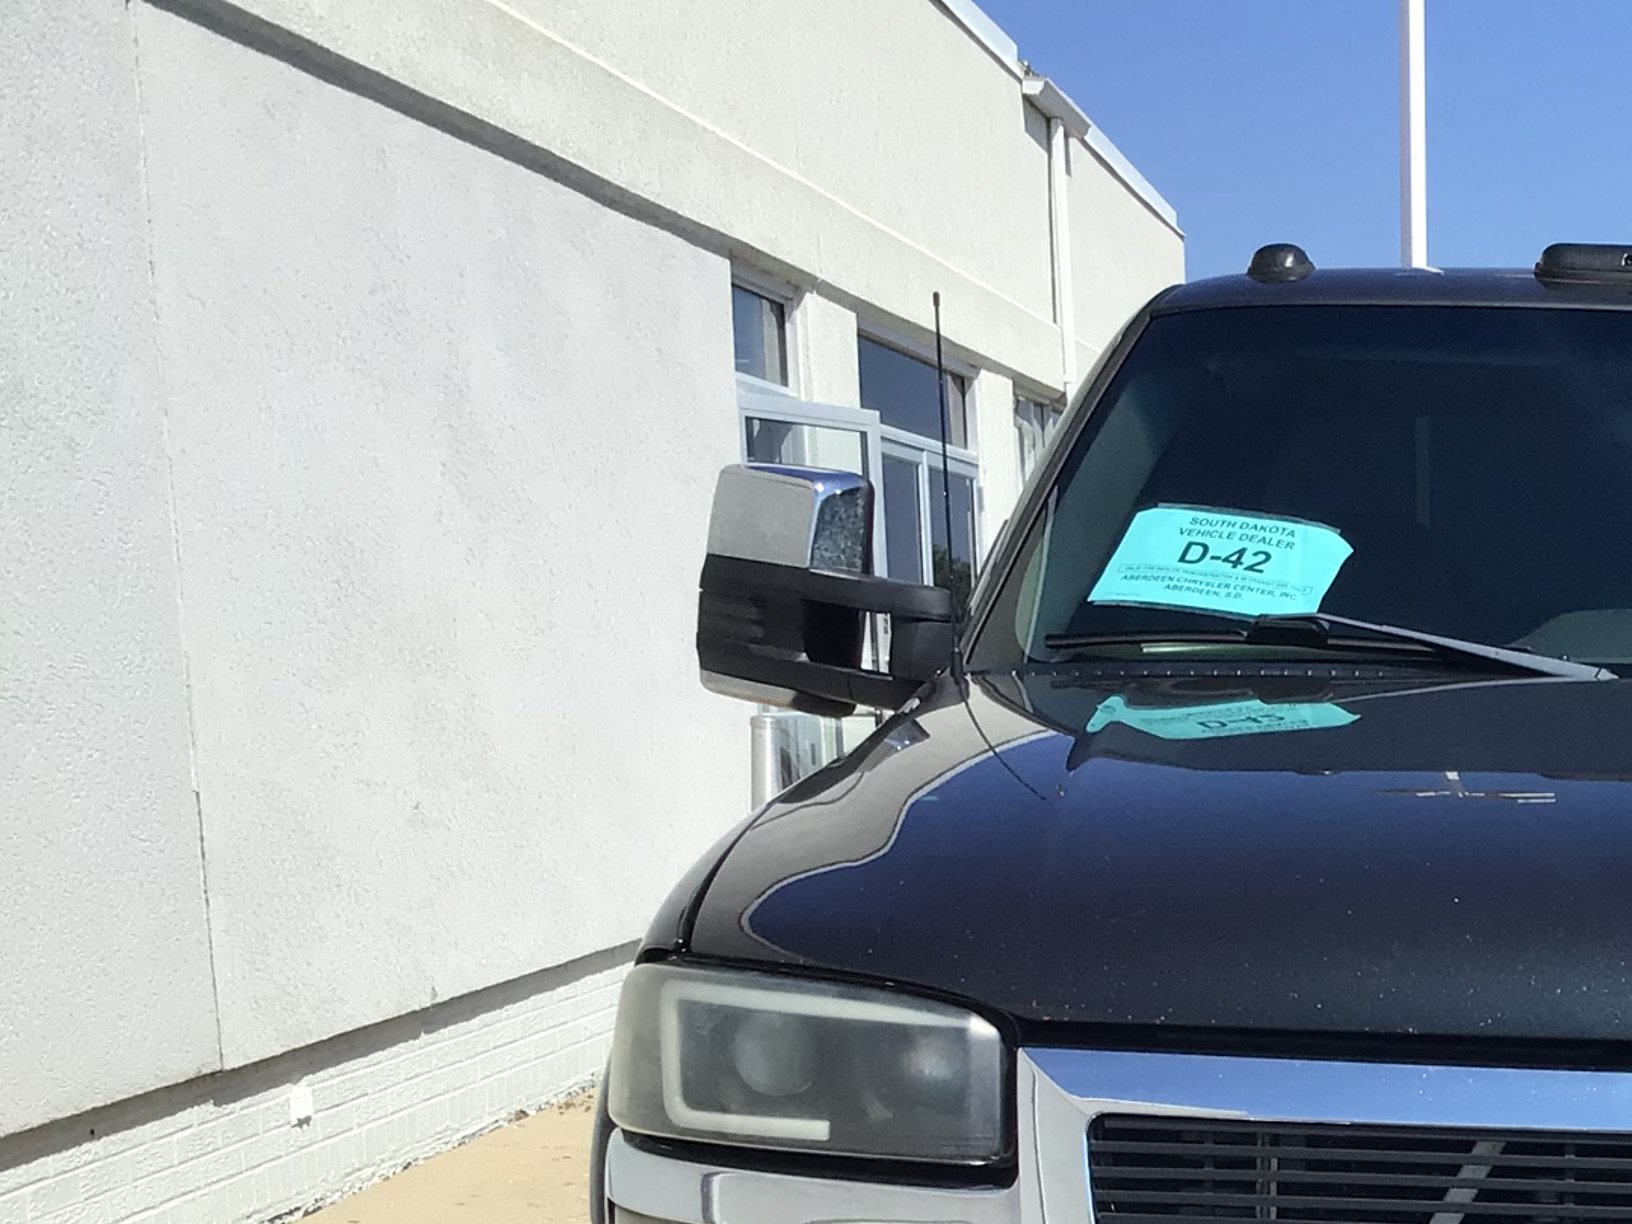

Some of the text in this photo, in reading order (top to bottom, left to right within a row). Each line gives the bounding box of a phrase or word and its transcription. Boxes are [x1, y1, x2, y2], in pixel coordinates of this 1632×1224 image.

[1178, 526, 1296, 550] VEHICLE DEALER
[1188, 516, 1296, 539] SOUTH DAKOTA
[1177, 540, 1272, 574] D-42
[1121, 574, 1176, 583] ABERDEEN
[1176, 577, 1232, 590] CHRYSLER
